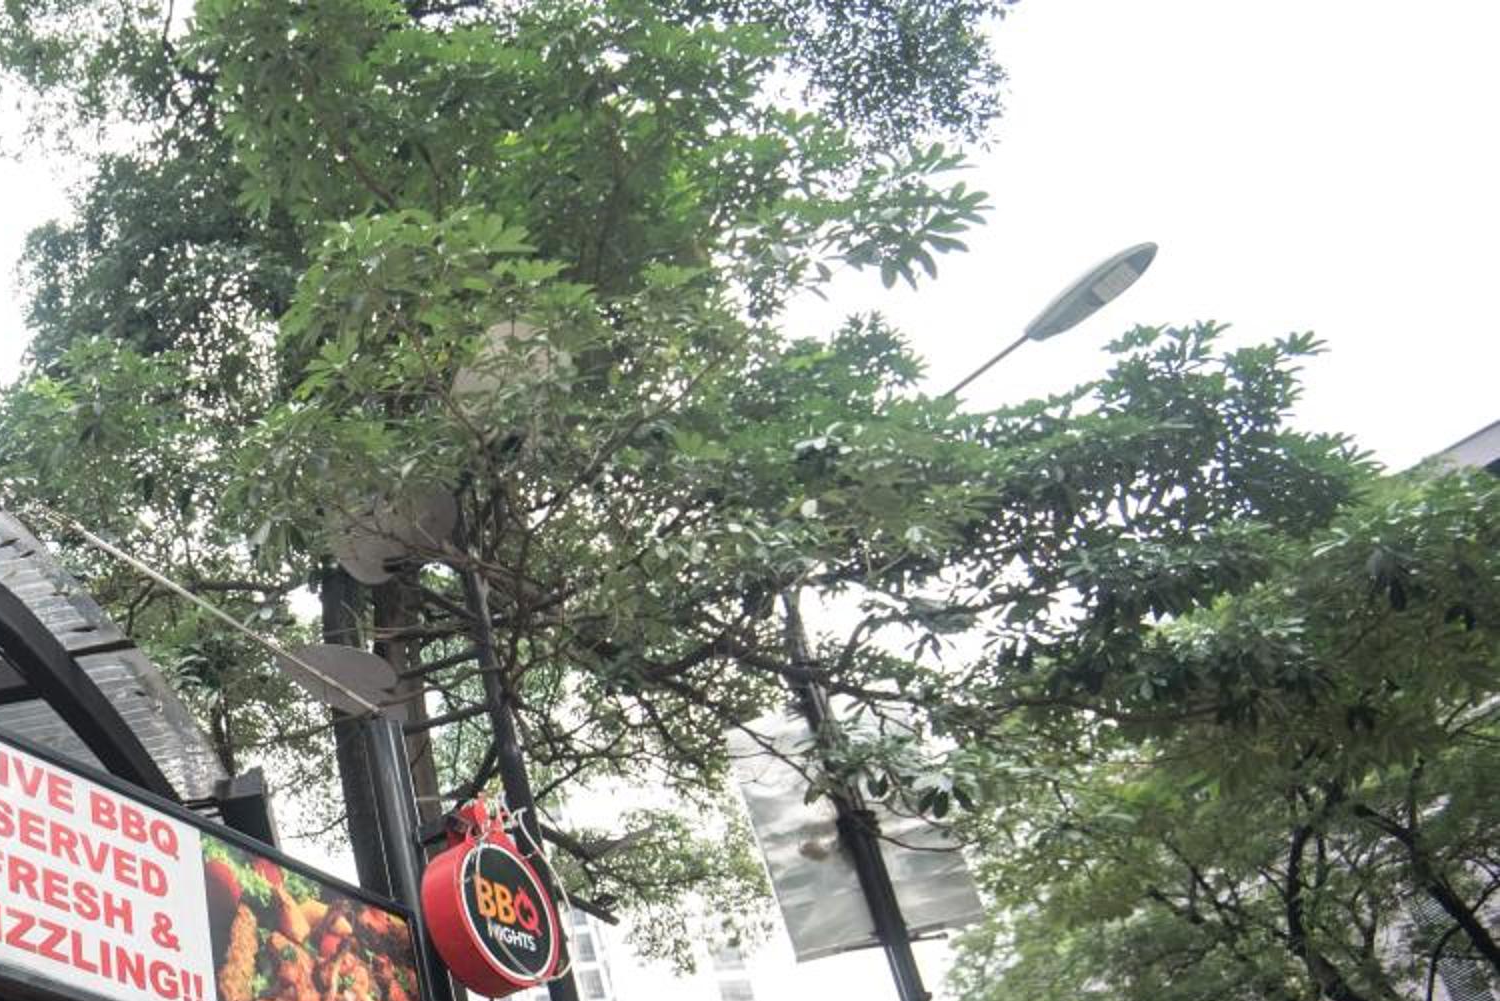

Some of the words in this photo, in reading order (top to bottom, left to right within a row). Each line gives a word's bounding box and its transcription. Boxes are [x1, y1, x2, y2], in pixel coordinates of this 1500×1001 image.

[90, 780, 182, 863] BBQ
[152, 908, 181, 953] &
[473, 872, 543, 937] BBQ
